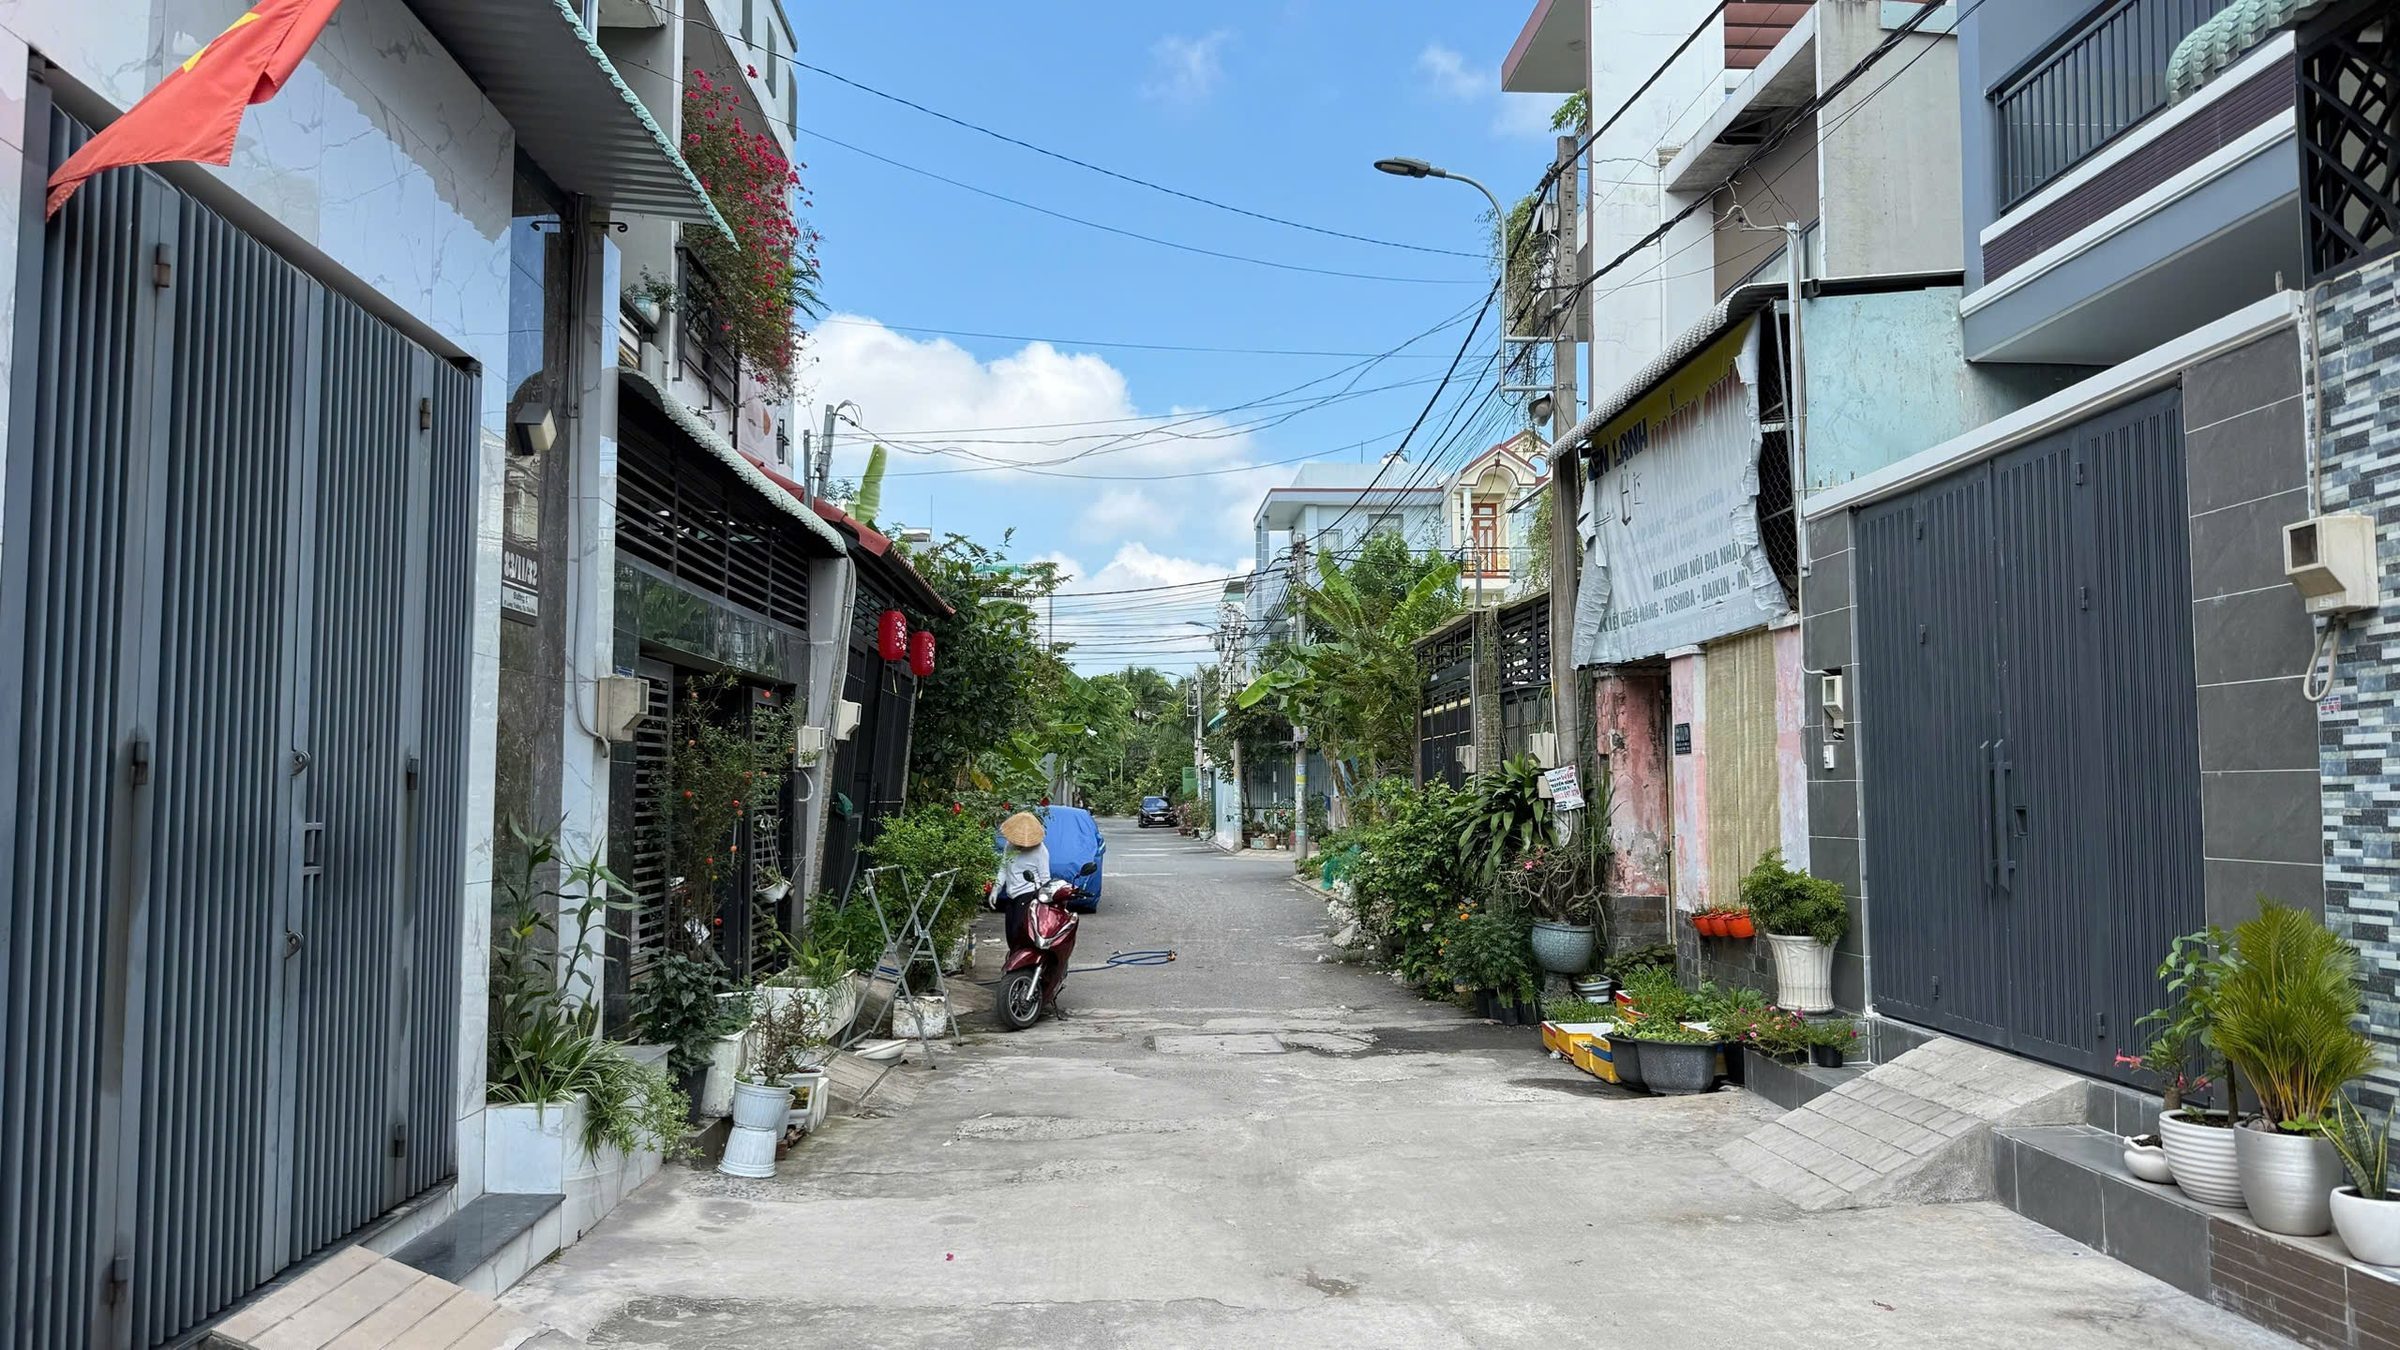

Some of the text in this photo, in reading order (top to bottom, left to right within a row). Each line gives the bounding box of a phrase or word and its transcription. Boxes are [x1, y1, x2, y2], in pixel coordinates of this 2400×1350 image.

[504, 551, 538, 586] 83/11/32
[1652, 570, 1668, 592] MÁY
[1669, 562, 1689, 588] LẠNH
[1690, 554, 1704, 579] NỘI
[1704, 550, 1719, 574] ĐỊA
[1664, 589, 1696, 614] TOSHIBA
[1702, 576, 1730, 602] DAIKIN
